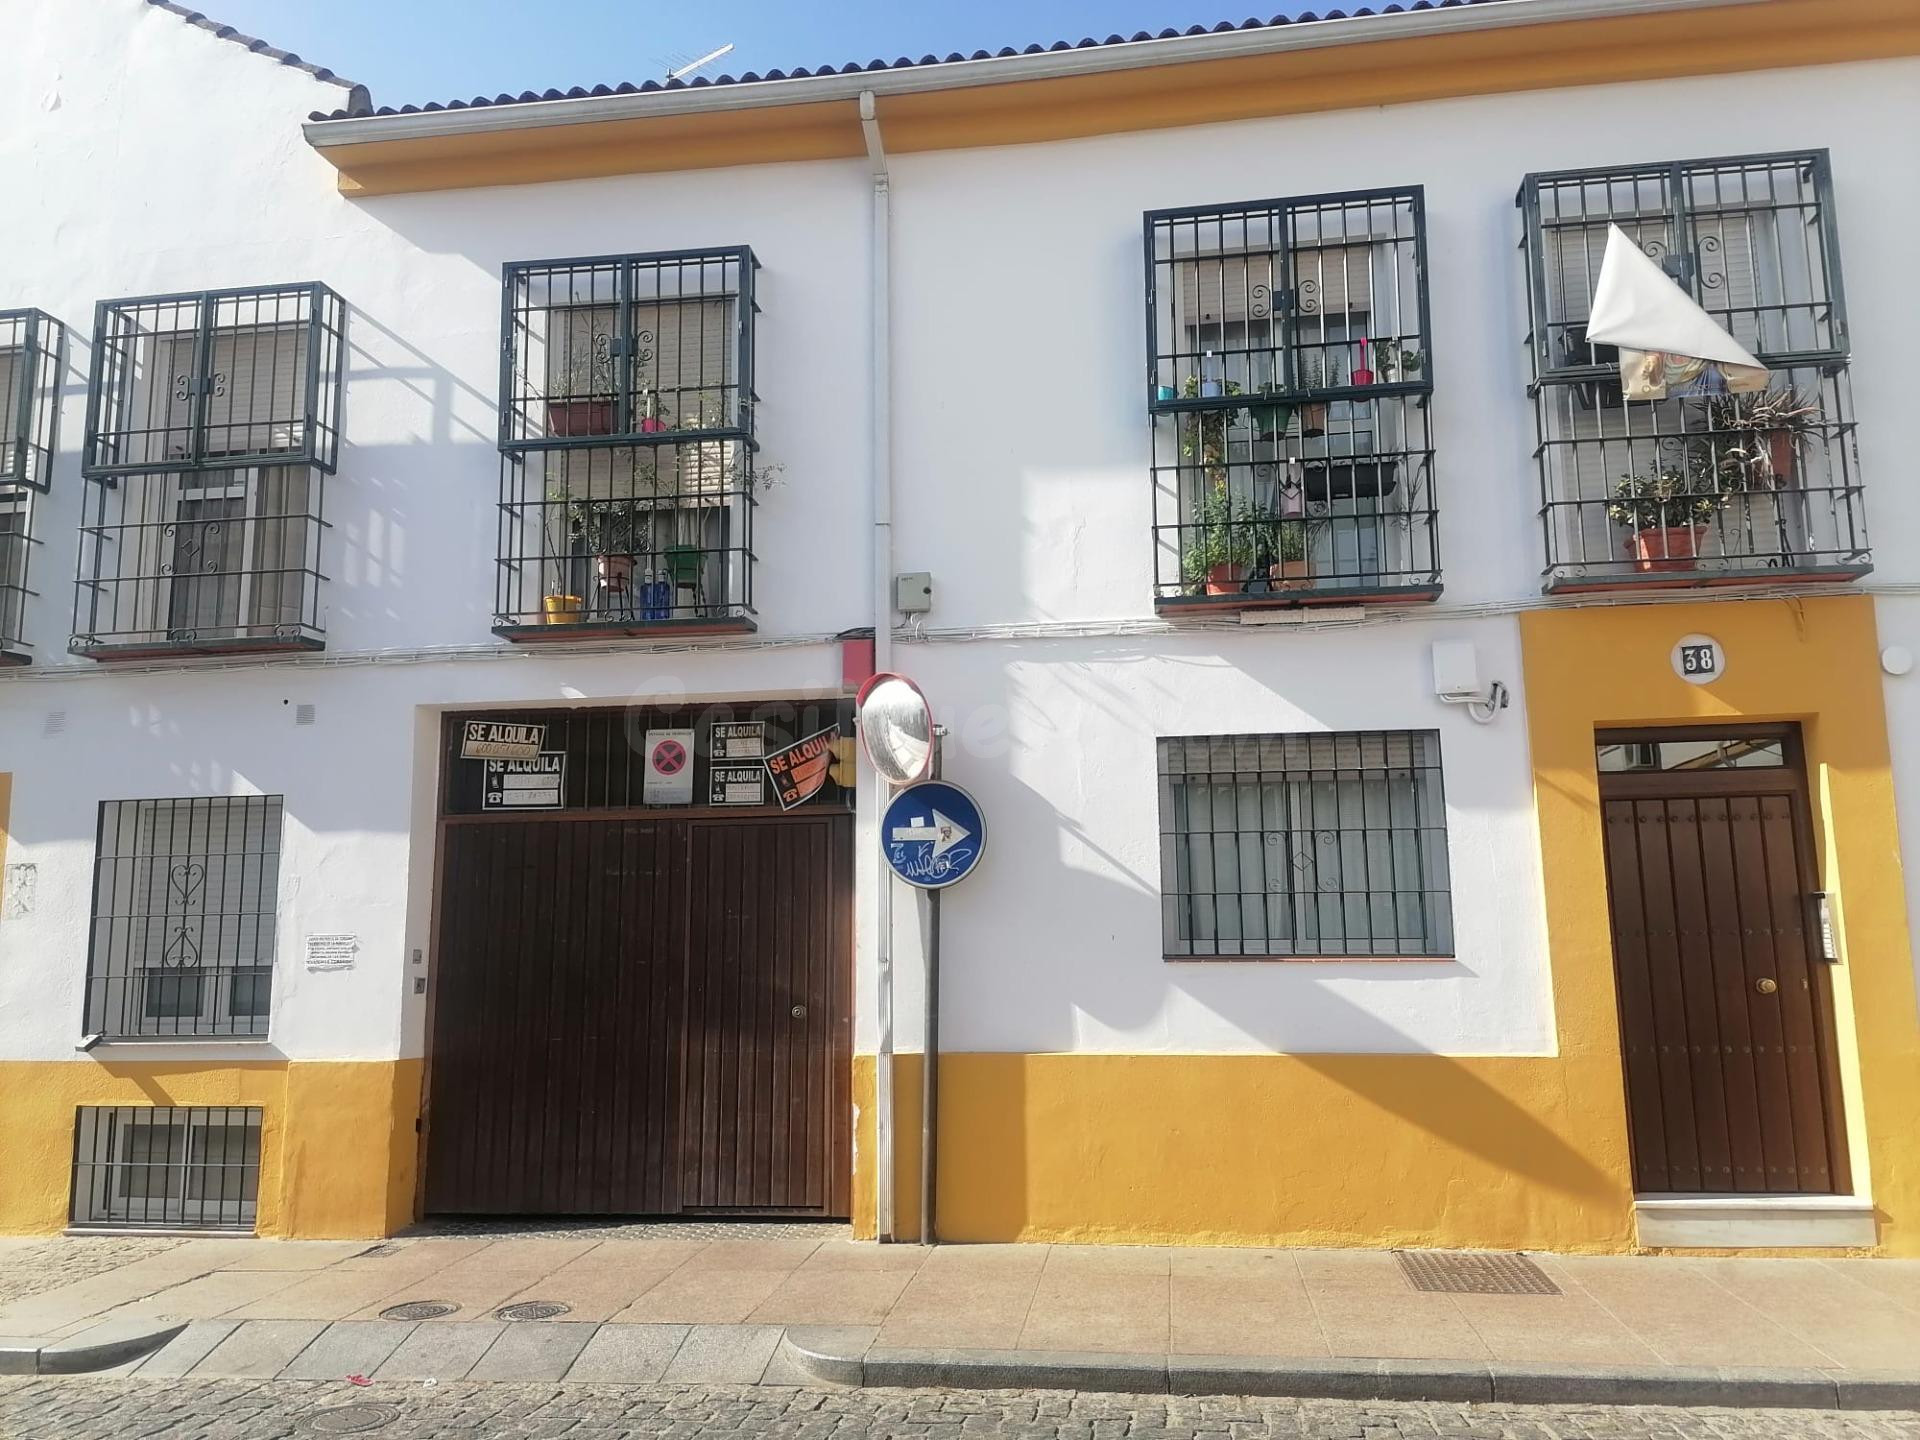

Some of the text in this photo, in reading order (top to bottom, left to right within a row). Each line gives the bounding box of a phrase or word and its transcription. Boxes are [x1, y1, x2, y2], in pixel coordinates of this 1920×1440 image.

[1684, 648, 1713, 671] 38
[468, 724, 539, 744] SE ALQUILA
[715, 726, 761, 738] SE ALQUILA
[489, 757, 560, 773] SE ALQUILA
[770, 755, 789, 774] SE
[714, 770, 761, 783] SE ALQUILA
